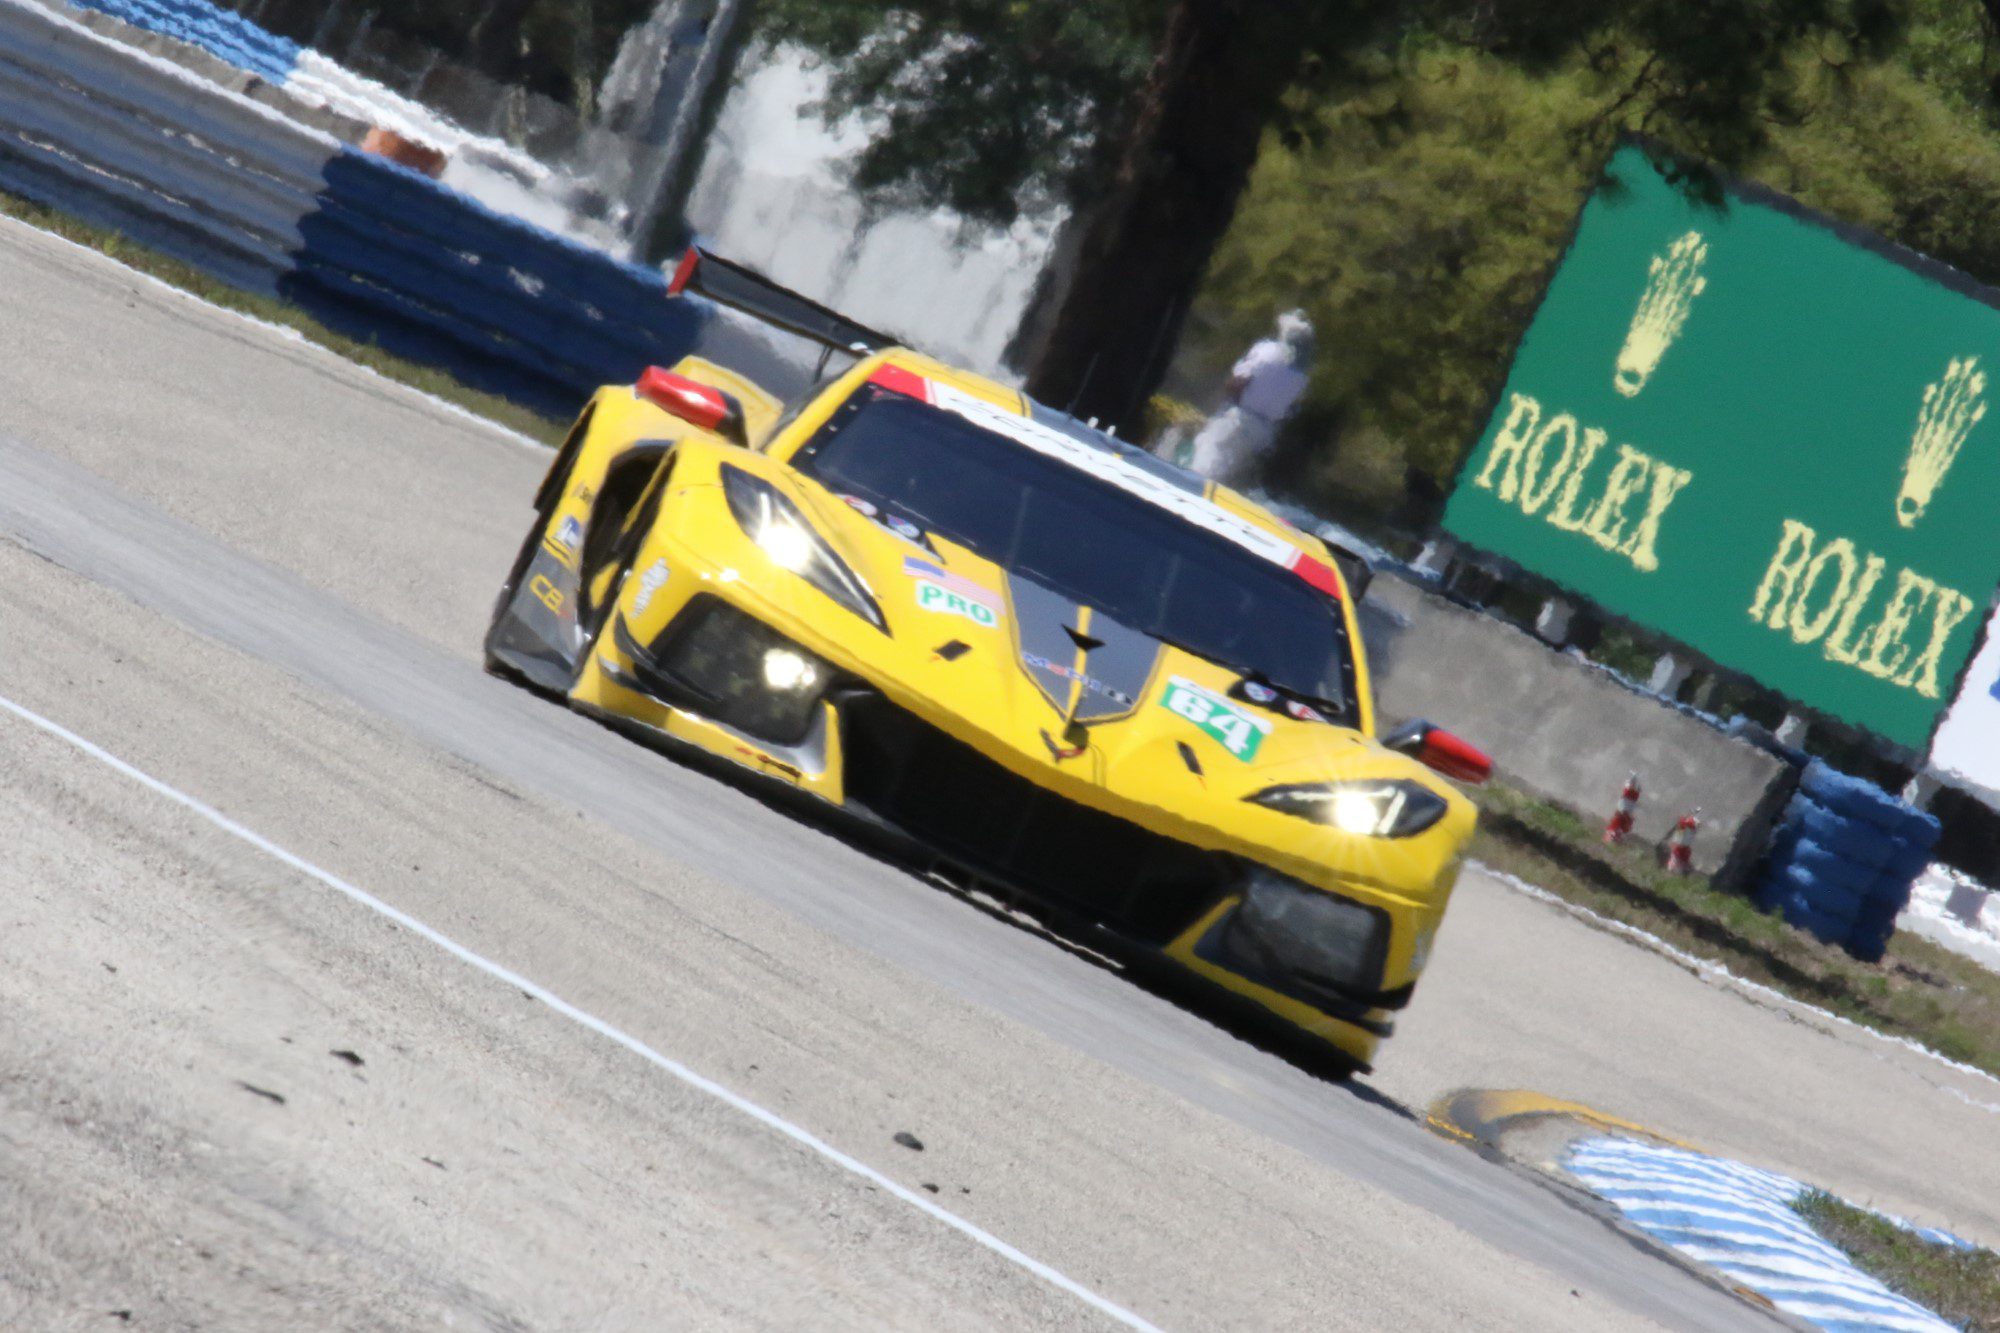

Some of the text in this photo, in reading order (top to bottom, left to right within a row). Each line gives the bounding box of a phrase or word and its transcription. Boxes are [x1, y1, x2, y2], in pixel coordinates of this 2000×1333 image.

[1475, 392, 1692, 572] ROLEX
[920, 584, 994, 624] PRO
[1747, 518, 1974, 698] ROLEX
[1167, 686, 1251, 754] 64
